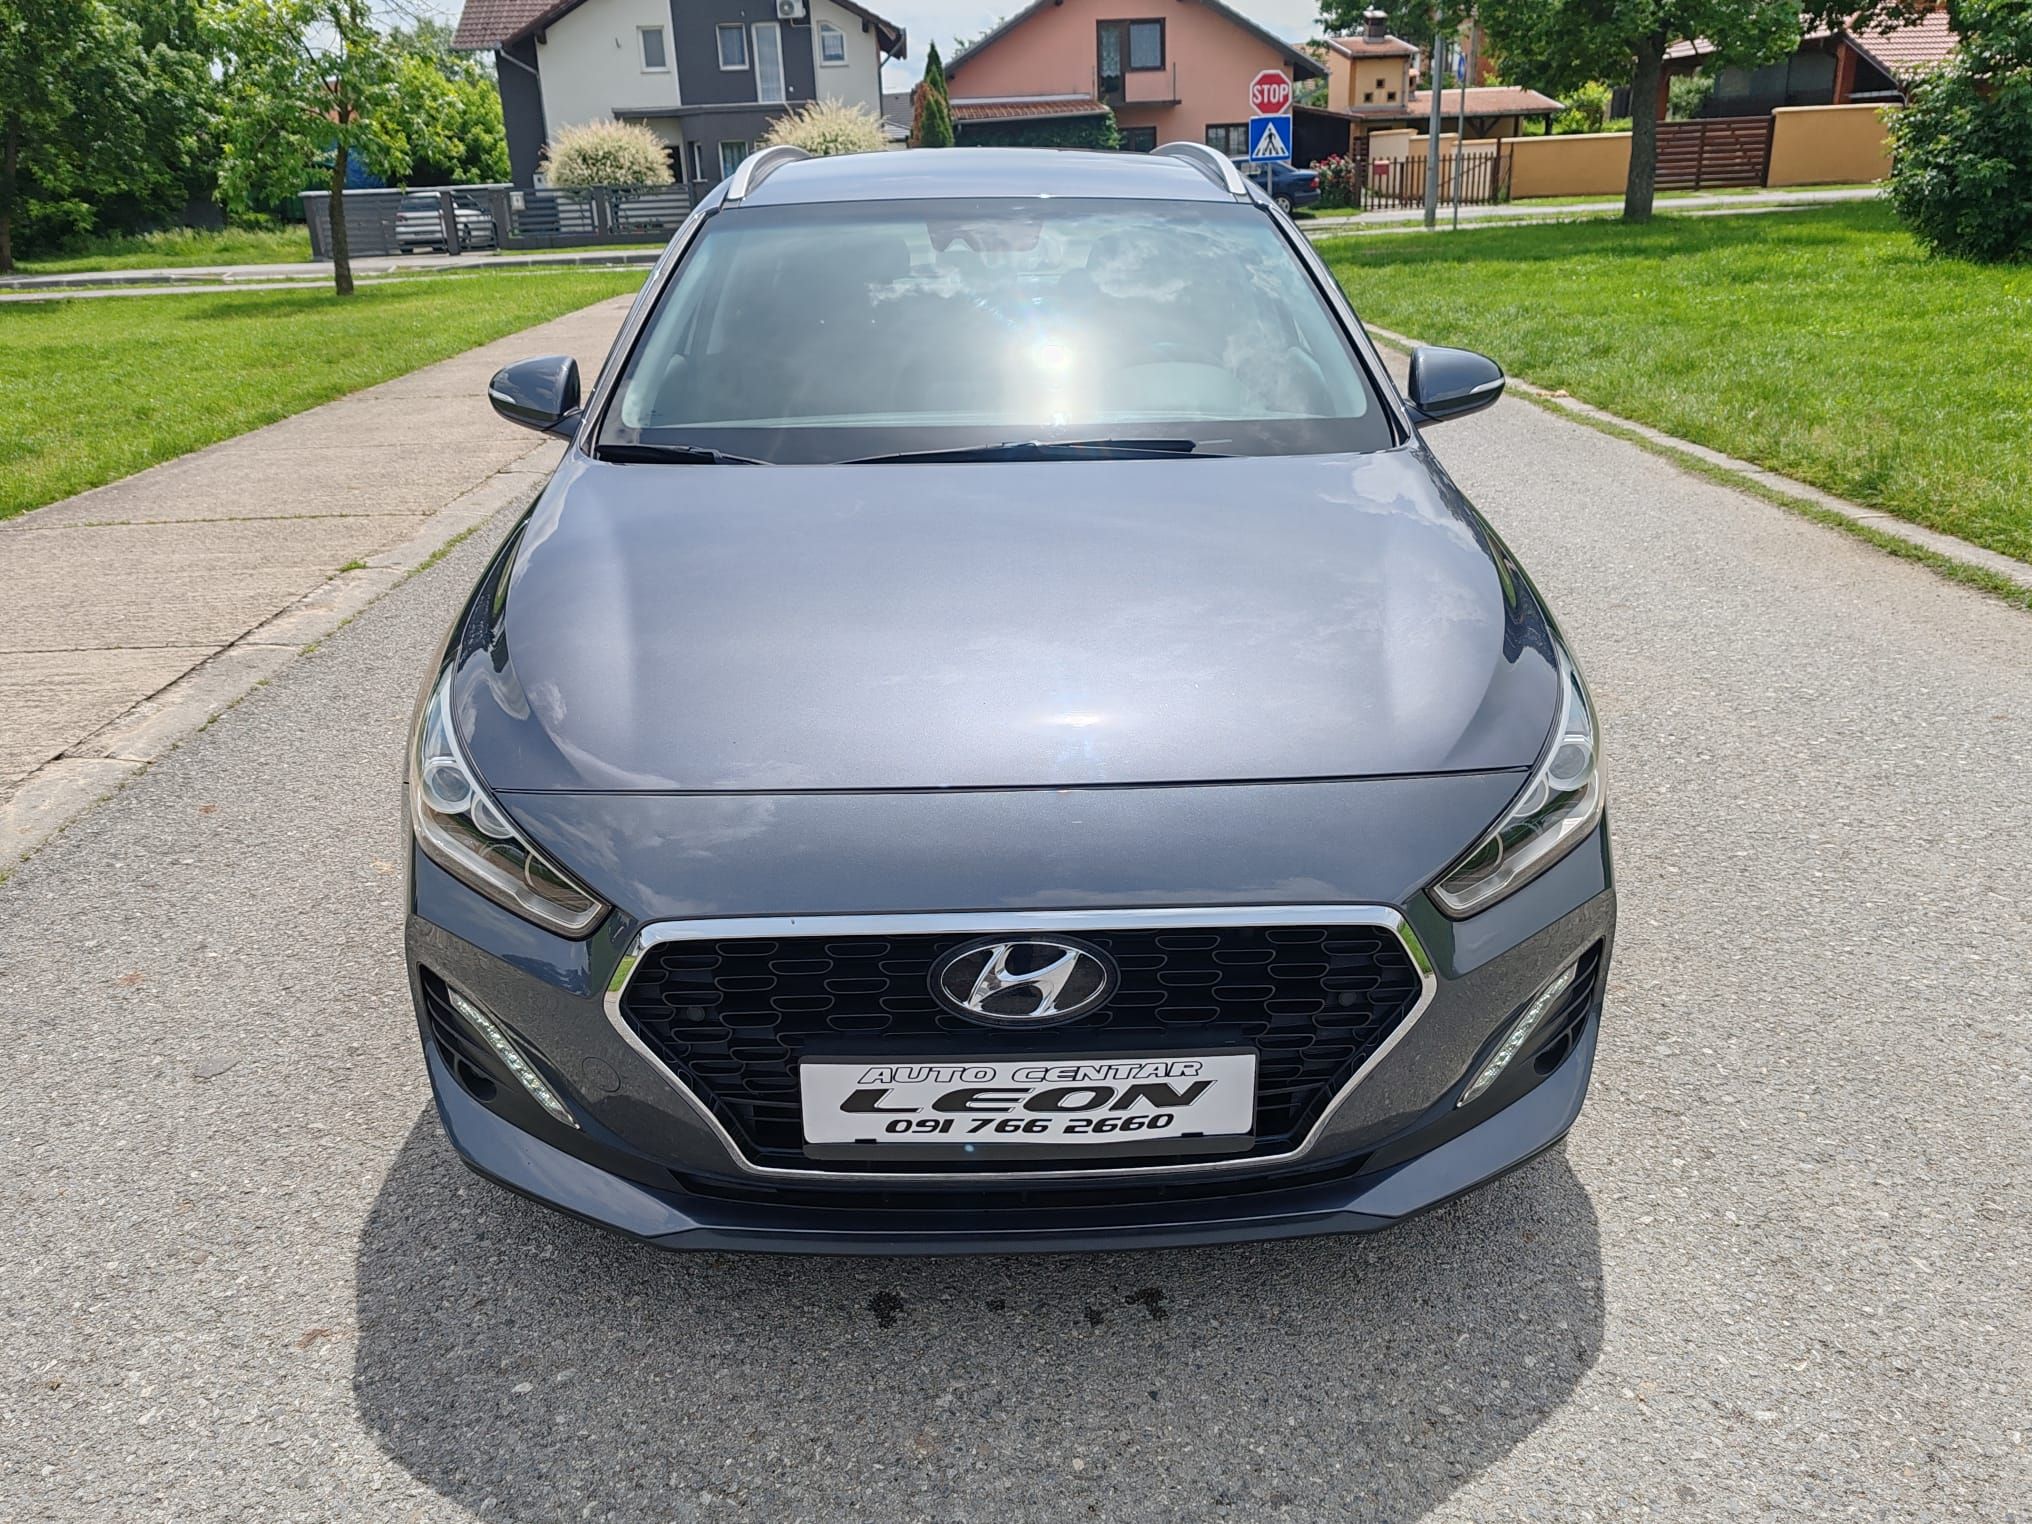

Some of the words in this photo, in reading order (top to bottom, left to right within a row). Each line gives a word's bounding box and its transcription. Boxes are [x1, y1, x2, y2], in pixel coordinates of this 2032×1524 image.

[1253, 84, 1289, 104] STOP
[857, 1066, 997, 1085] AUTO
[1011, 1061, 1203, 1083] CENTAR
[839, 1080, 1218, 1114] LEON
[885, 1118, 955, 1134] 091
[965, 1118, 1053, 1134] 766
[1062, 1113, 1175, 1134] 2660
